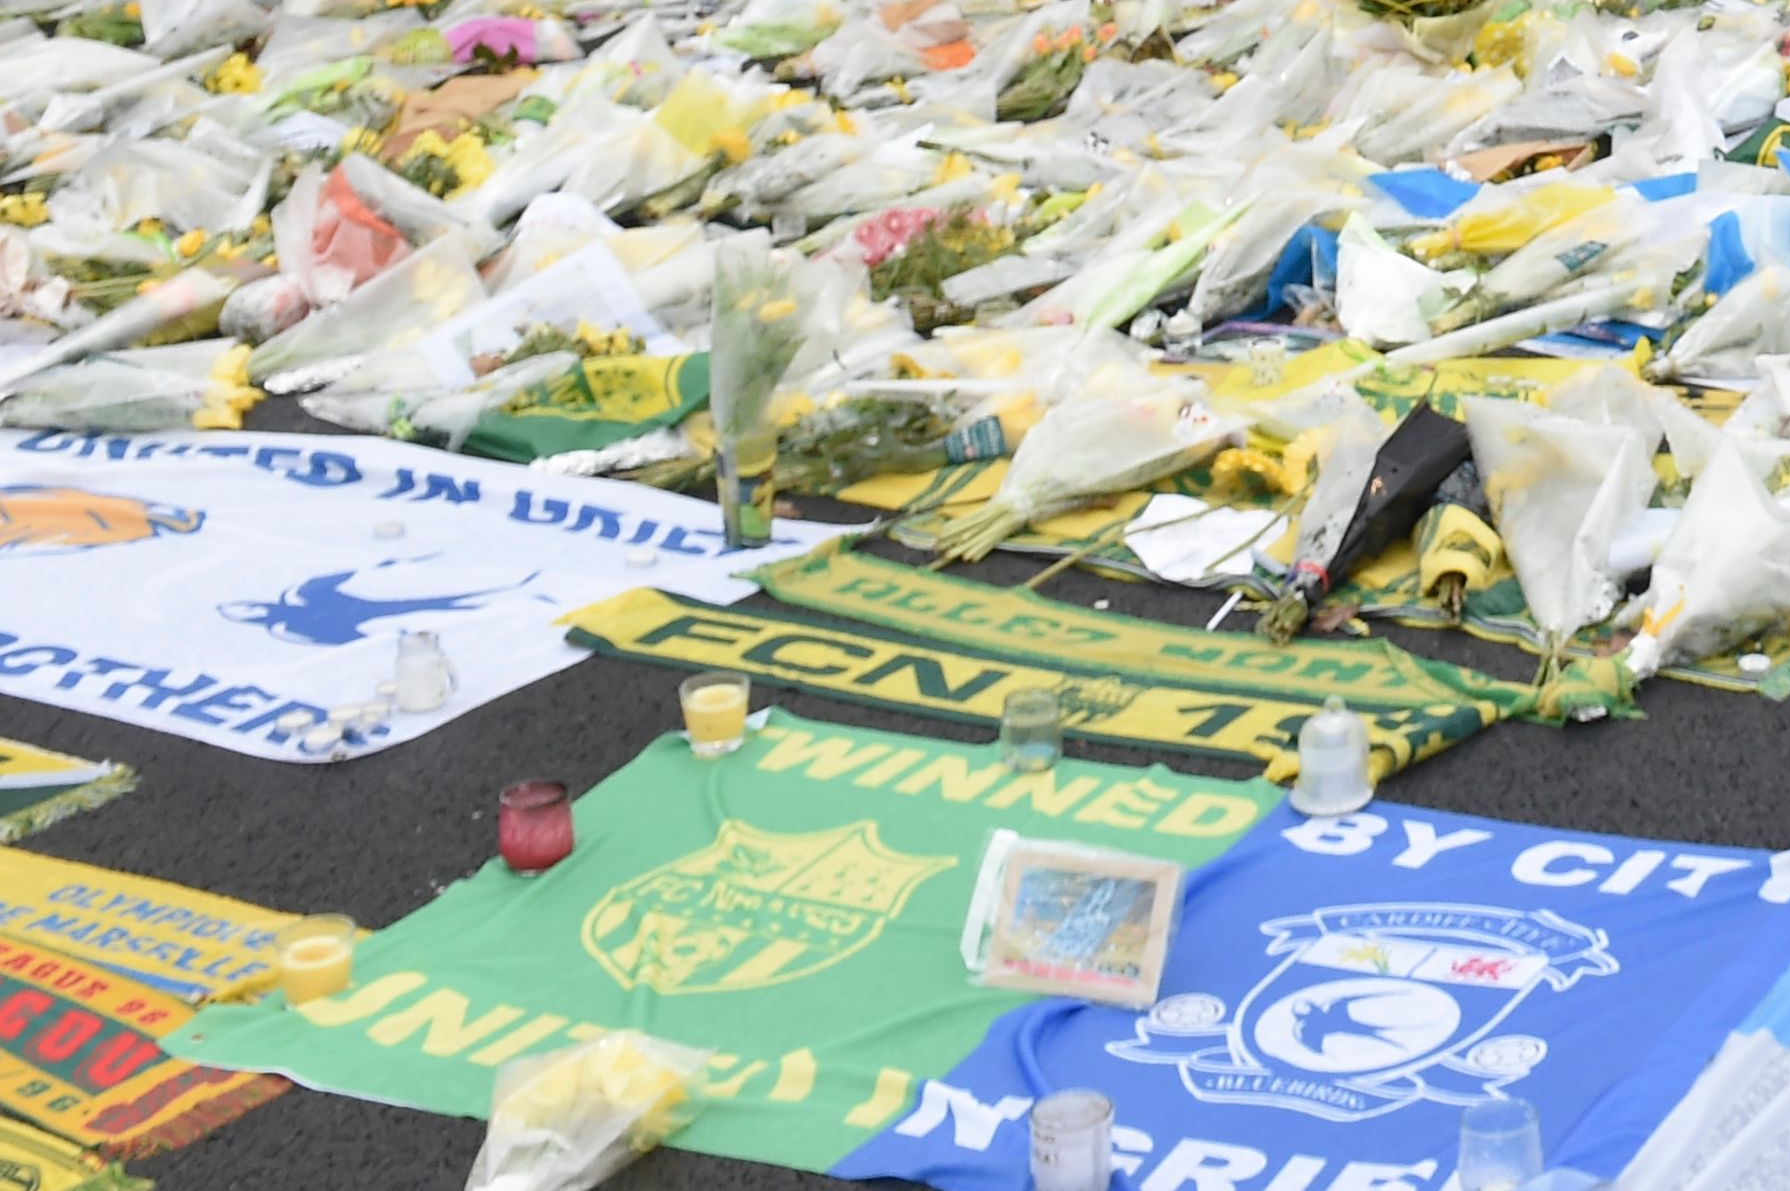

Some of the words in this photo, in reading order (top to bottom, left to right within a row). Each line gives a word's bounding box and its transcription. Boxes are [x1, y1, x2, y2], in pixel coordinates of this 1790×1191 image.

[507, 489, 799, 558] GRIE
[834, 576, 1119, 645] ALLEZ
[633, 614, 1010, 704] FCN
[1280, 811, 1493, 871] BY
[0, 980, 162, 1089] COU
